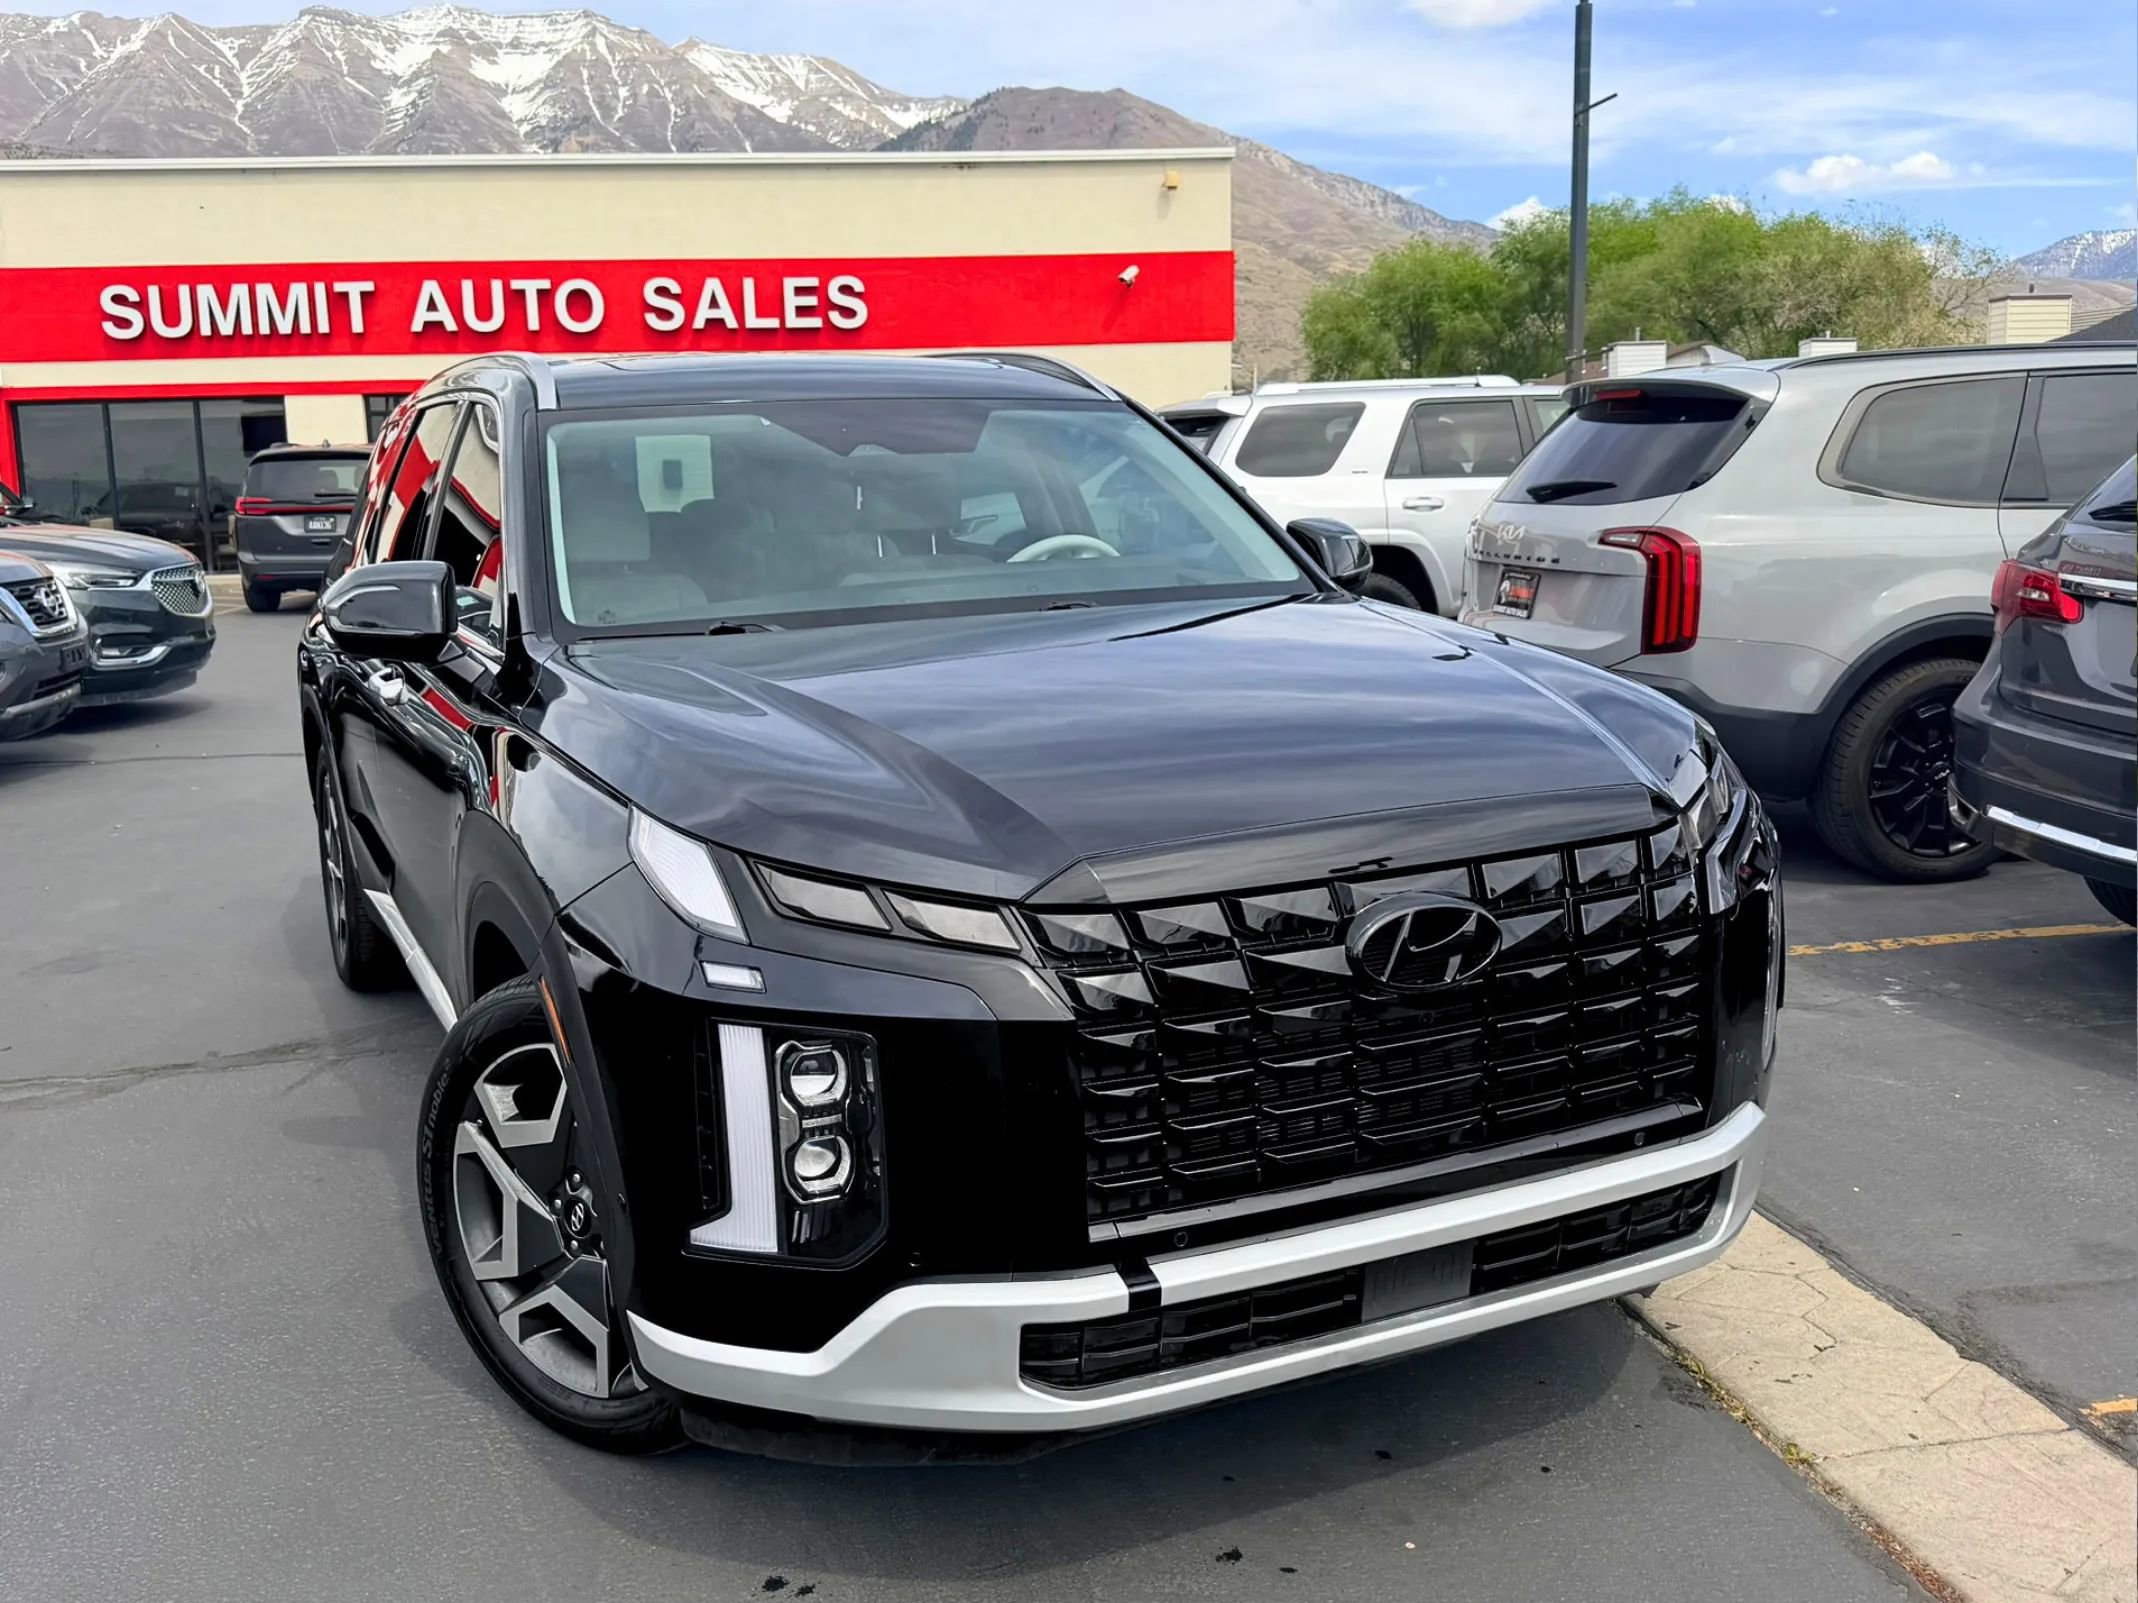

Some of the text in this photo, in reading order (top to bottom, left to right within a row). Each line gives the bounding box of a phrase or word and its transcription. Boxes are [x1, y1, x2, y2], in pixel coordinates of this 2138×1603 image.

[99, 275, 868, 340] SUMMIT AUTO SALES
